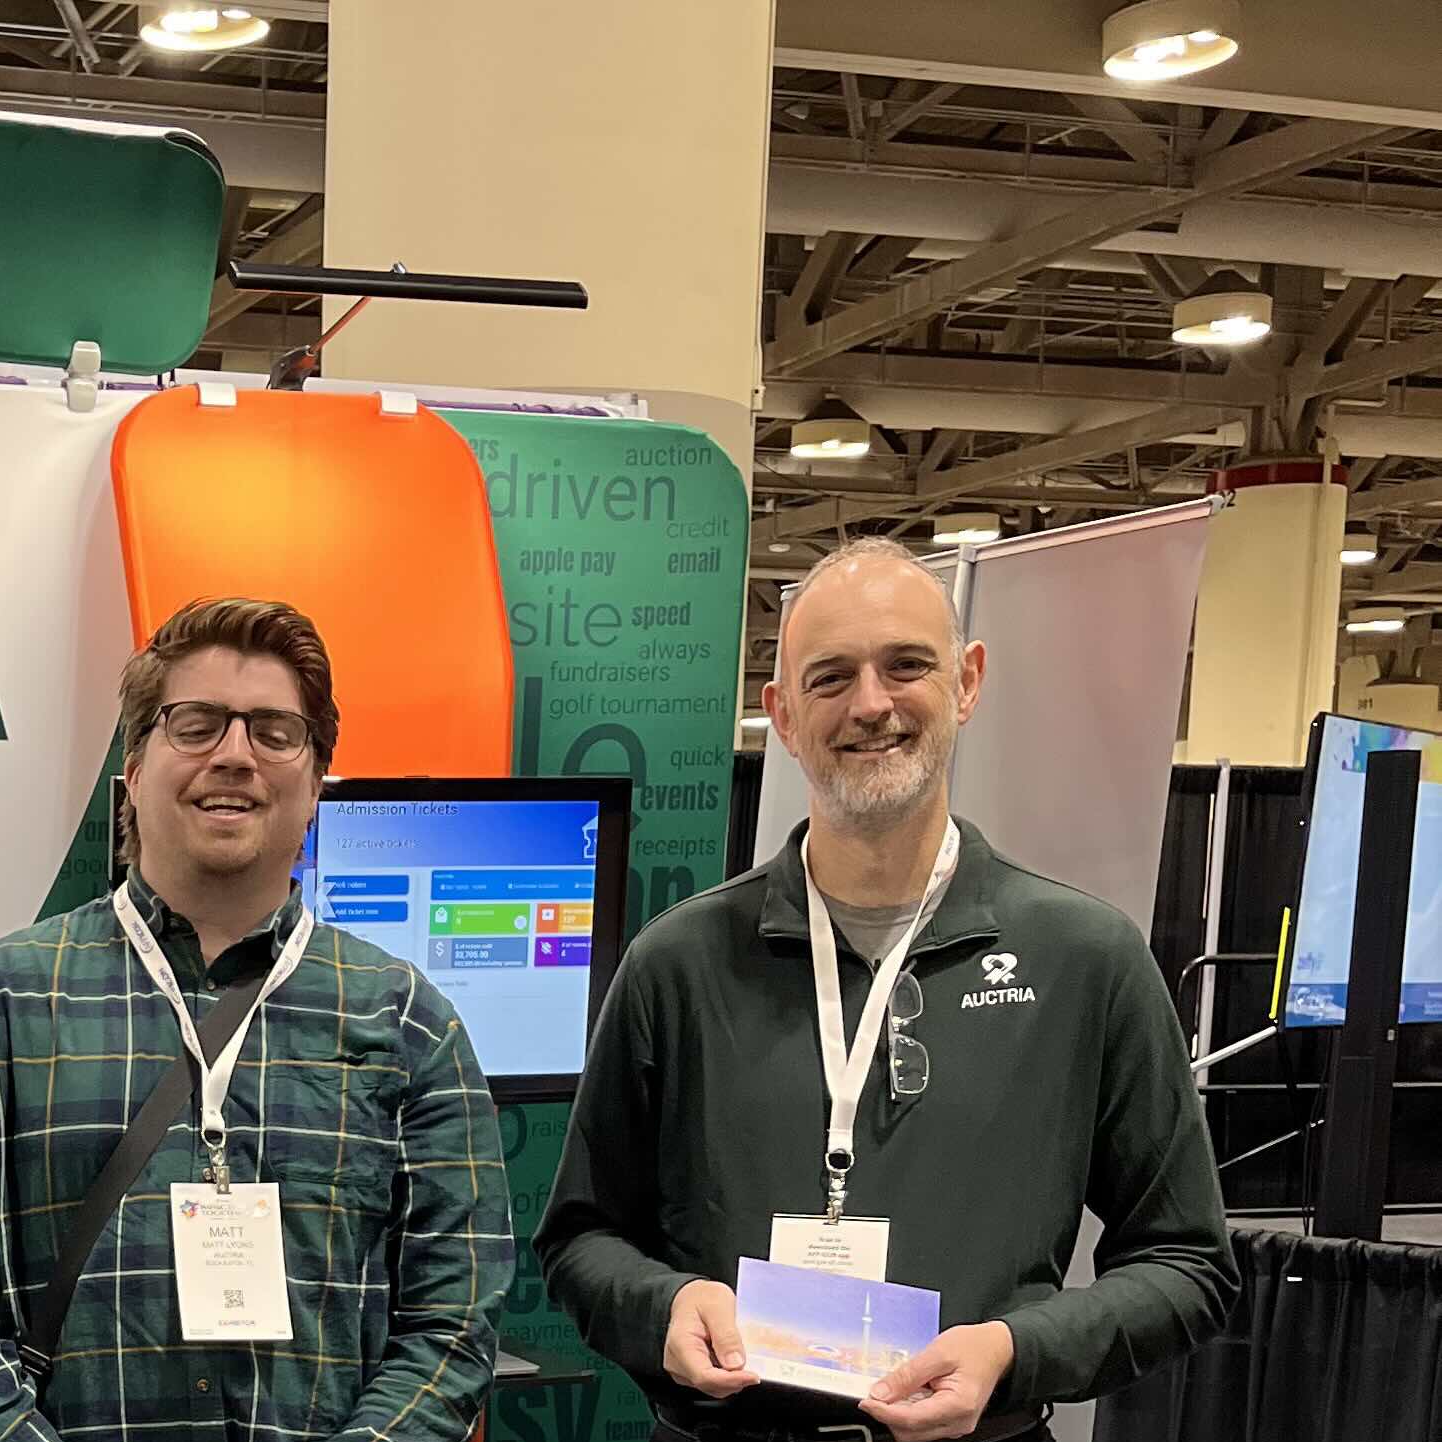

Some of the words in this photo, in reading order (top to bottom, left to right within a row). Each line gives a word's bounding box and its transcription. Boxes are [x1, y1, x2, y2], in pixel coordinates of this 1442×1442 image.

[625, 446, 712, 468] auction
[488, 453, 677, 521] driven
[667, 517, 730, 538] credit
[520, 548, 574, 575] apple
[581, 551, 616, 576] pay
[668, 547, 722, 574] email
[631, 601, 691, 630] speed
[637, 639, 711, 664] always
[550, 661, 671, 683] fundraisers
[549, 694, 594, 718] golf
[600, 694, 727, 715] tournament
[670, 748, 726, 770] quick
[640, 781, 718, 812] events
[336, 802, 406, 815] Admission
[411, 802, 459, 815] Tickets
[635, 836, 717, 859] receipts
[961, 986, 1036, 1009] AUCTRIA
[209, 1226, 244, 1238] MATT
